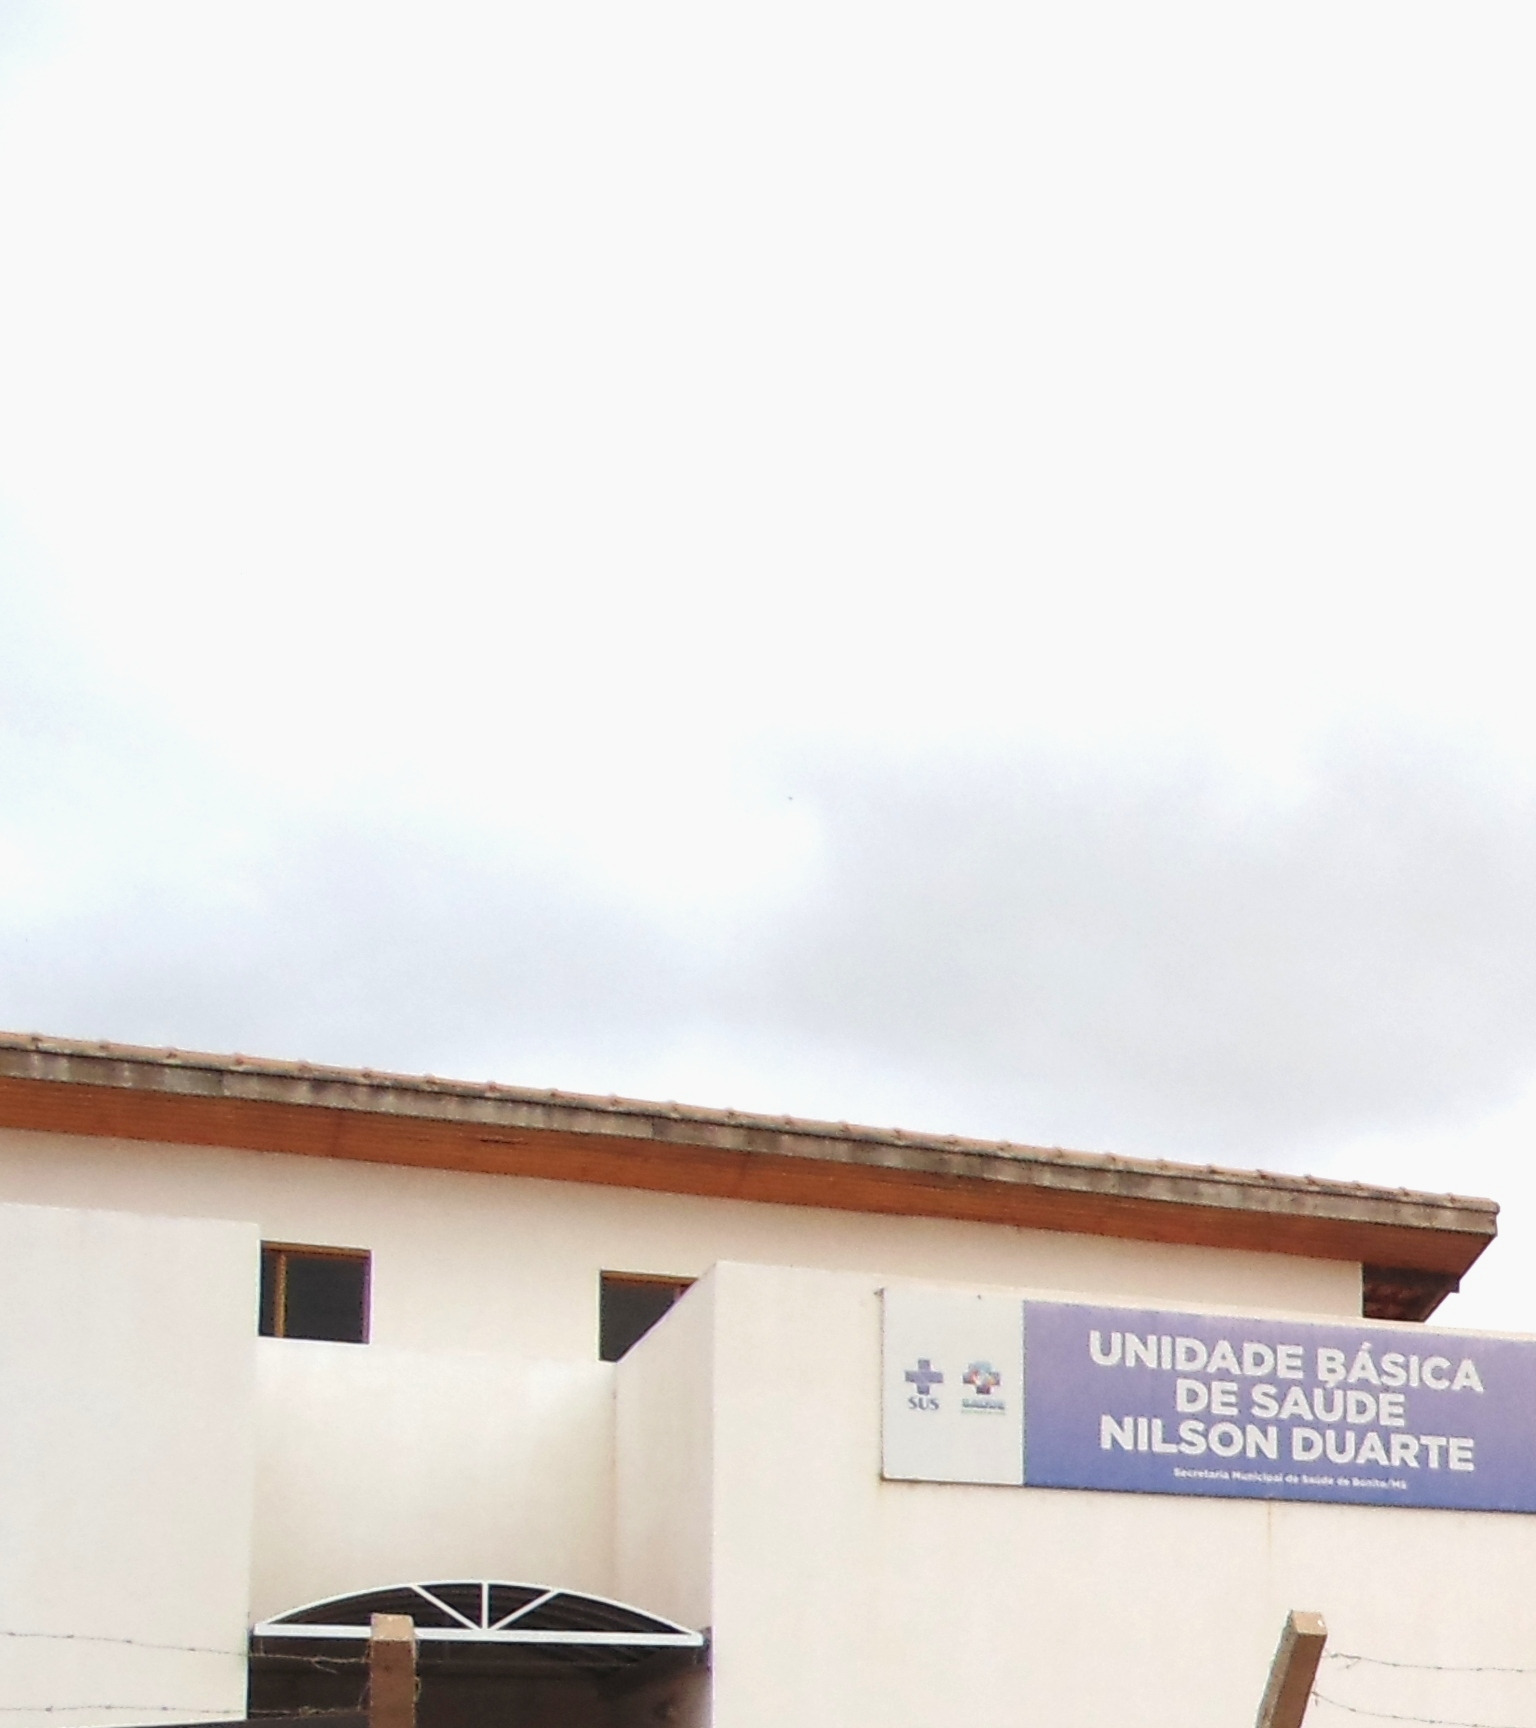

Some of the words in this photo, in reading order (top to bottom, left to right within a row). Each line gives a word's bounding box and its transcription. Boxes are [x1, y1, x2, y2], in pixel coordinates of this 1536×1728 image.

[1089, 1329, 1303, 1379] UNIDADE
[1316, 1341, 1484, 1393] BÁSICA
[907, 1397, 940, 1410] SUS
[1175, 1378, 1239, 1416] DE
[1250, 1373, 1406, 1427] SAÚDE
[1100, 1414, 1278, 1460] NILSON
[1291, 1427, 1475, 1472] DUARTE
[1173, 1467, 1229, 1480] Secretaria
[1231, 1471, 1283, 1483] Municipal
[1285, 1474, 1299, 1484] de
[1301, 1474, 1334, 1486] Saúde
